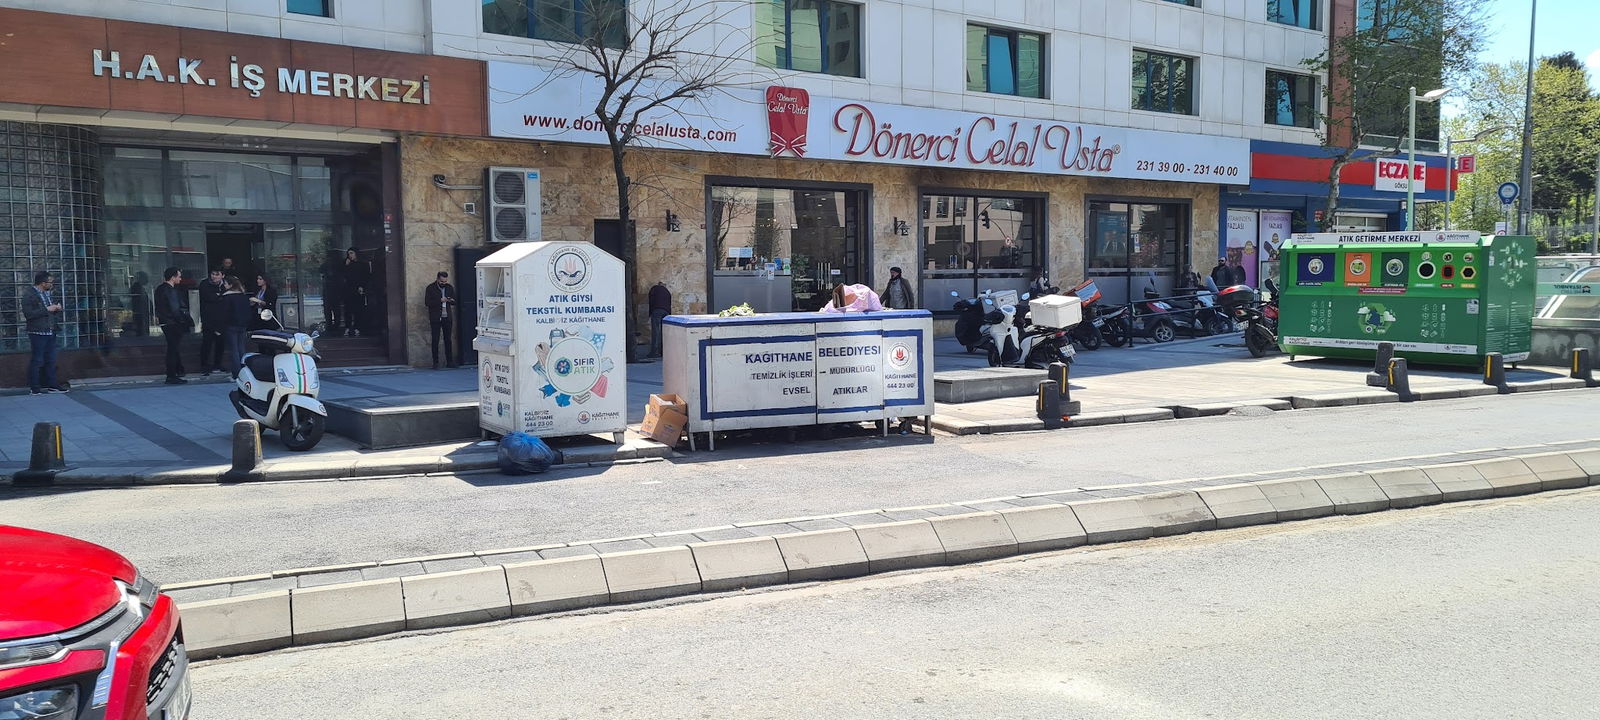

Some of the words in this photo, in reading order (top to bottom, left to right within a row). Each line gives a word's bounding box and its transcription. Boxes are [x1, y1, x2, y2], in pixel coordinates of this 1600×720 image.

[93, 49, 216, 86] H.A.K.
[230, 56, 266, 97] İŞ
[277, 67, 431, 105] MERKEZİ
[833, 103, 962, 163] Dönerci
[965, 116, 1042, 167] Celal
[1136, 160, 1155, 172] 231
[1158, 161, 1170, 173] 39
[1172, 163, 1185, 174] 00
[1193, 164, 1211, 175] 231
[1213, 165, 1225, 176] 40
[1226, 166, 1238, 177] 00
[1463, 159, 1470, 169] E
[1339, 234, 1353, 243] ATIK
[1355, 232, 1386, 242] GETİRME
[1388, 232, 1420, 242] MERKEZİ
[549, 294, 568, 303] ATIK
[526, 306, 562, 315] TEKSTİL
[565, 306, 615, 314] KUMBARASI
[574, 358, 595, 366] SIFIR
[574, 366, 595, 374] ATIK
[752, 370, 787, 380] TEMİZLİK
[788, 369, 813, 380] İŞLERİ
[783, 386, 811, 395] EVSEL
[832, 385, 868, 395] ATIKLAR
